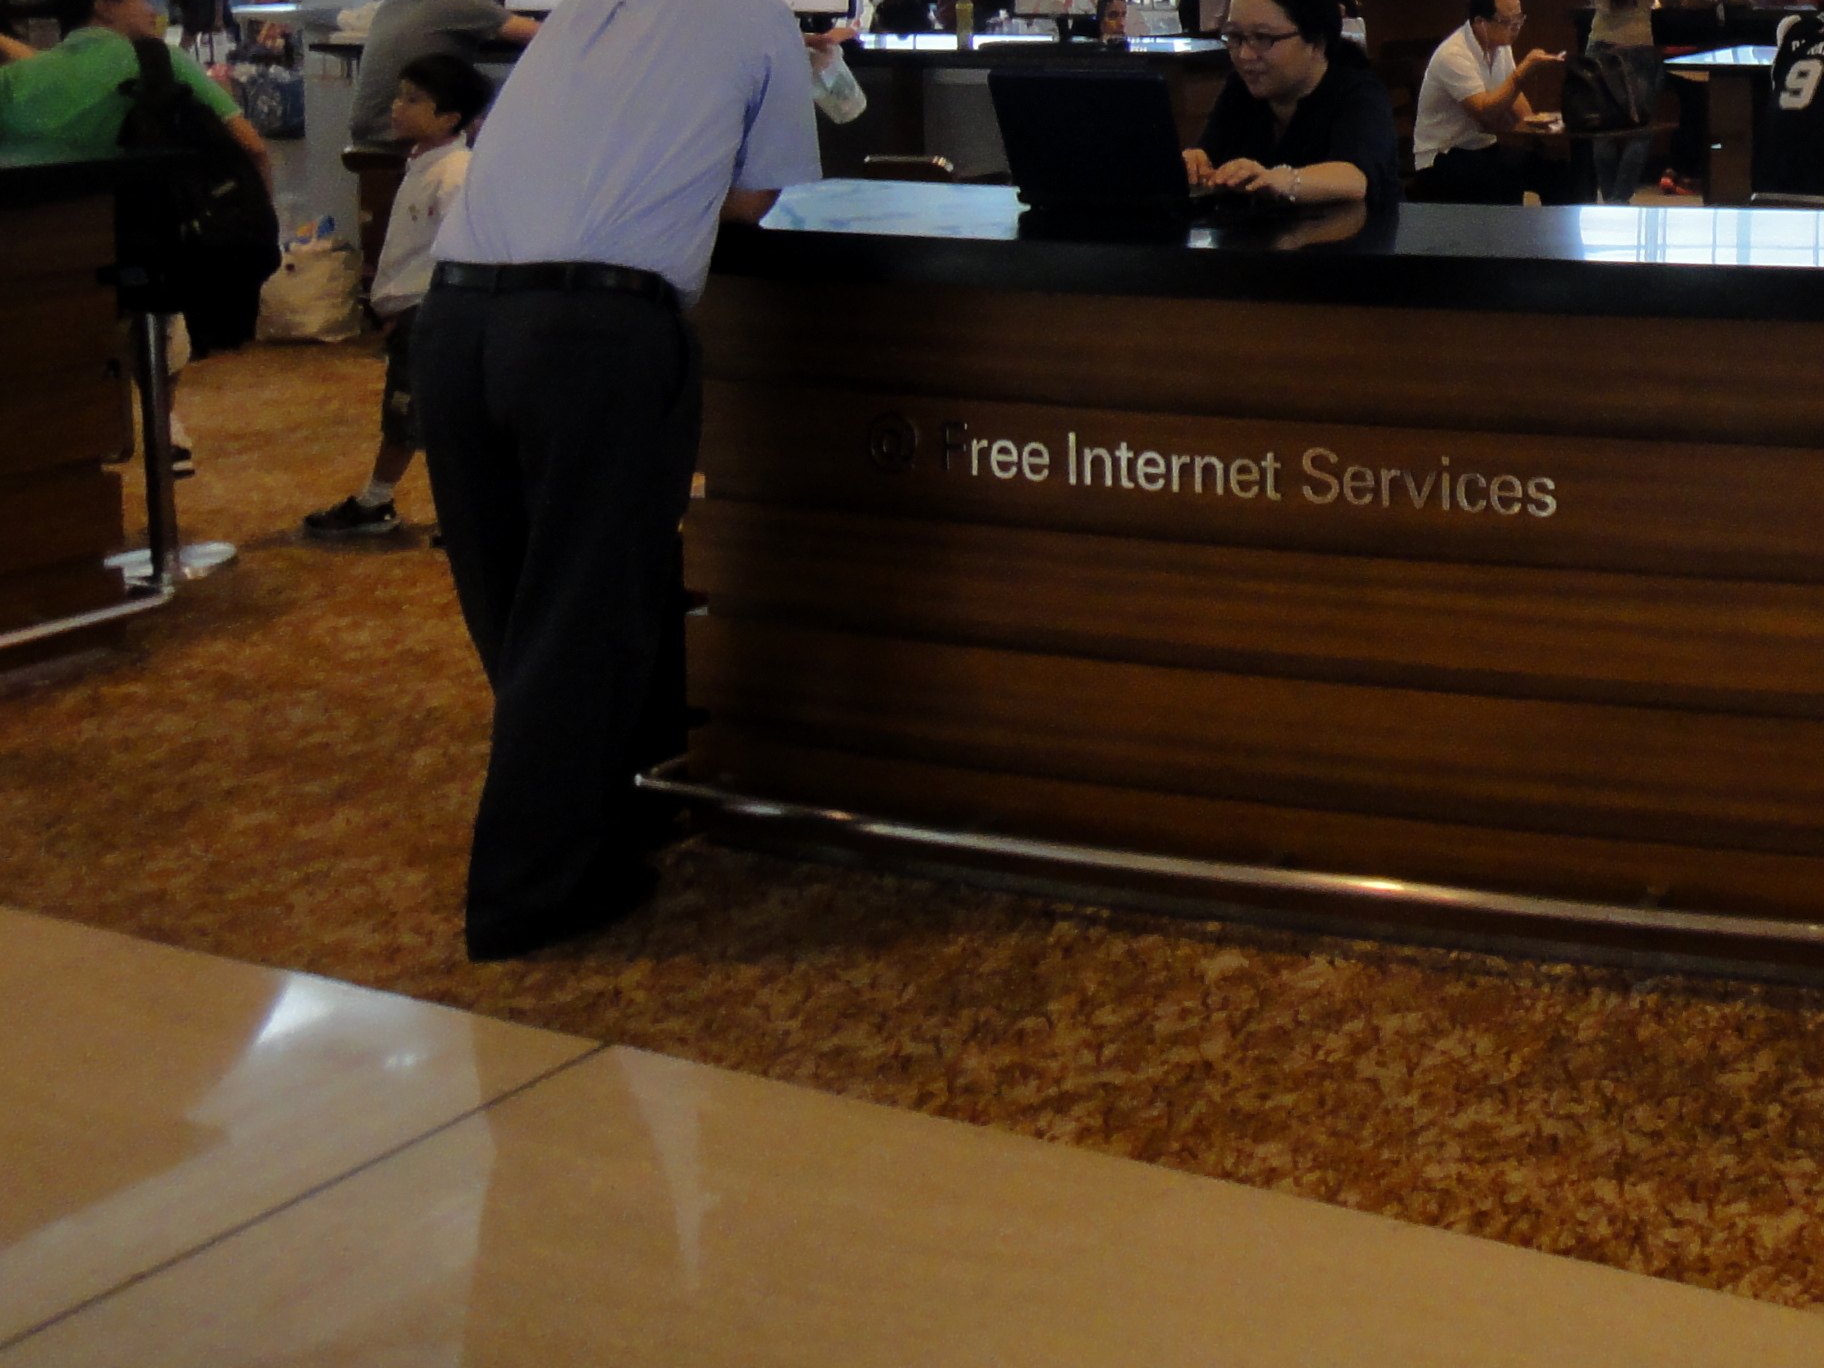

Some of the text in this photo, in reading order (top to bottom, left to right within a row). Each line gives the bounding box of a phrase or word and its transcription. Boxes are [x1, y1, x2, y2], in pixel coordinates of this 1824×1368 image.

[1779, 58, 1824, 110] 9
[942, 421, 1049, 481] Free
[1067, 431, 1283, 502] Internet
[1302, 446, 1558, 518] Services
